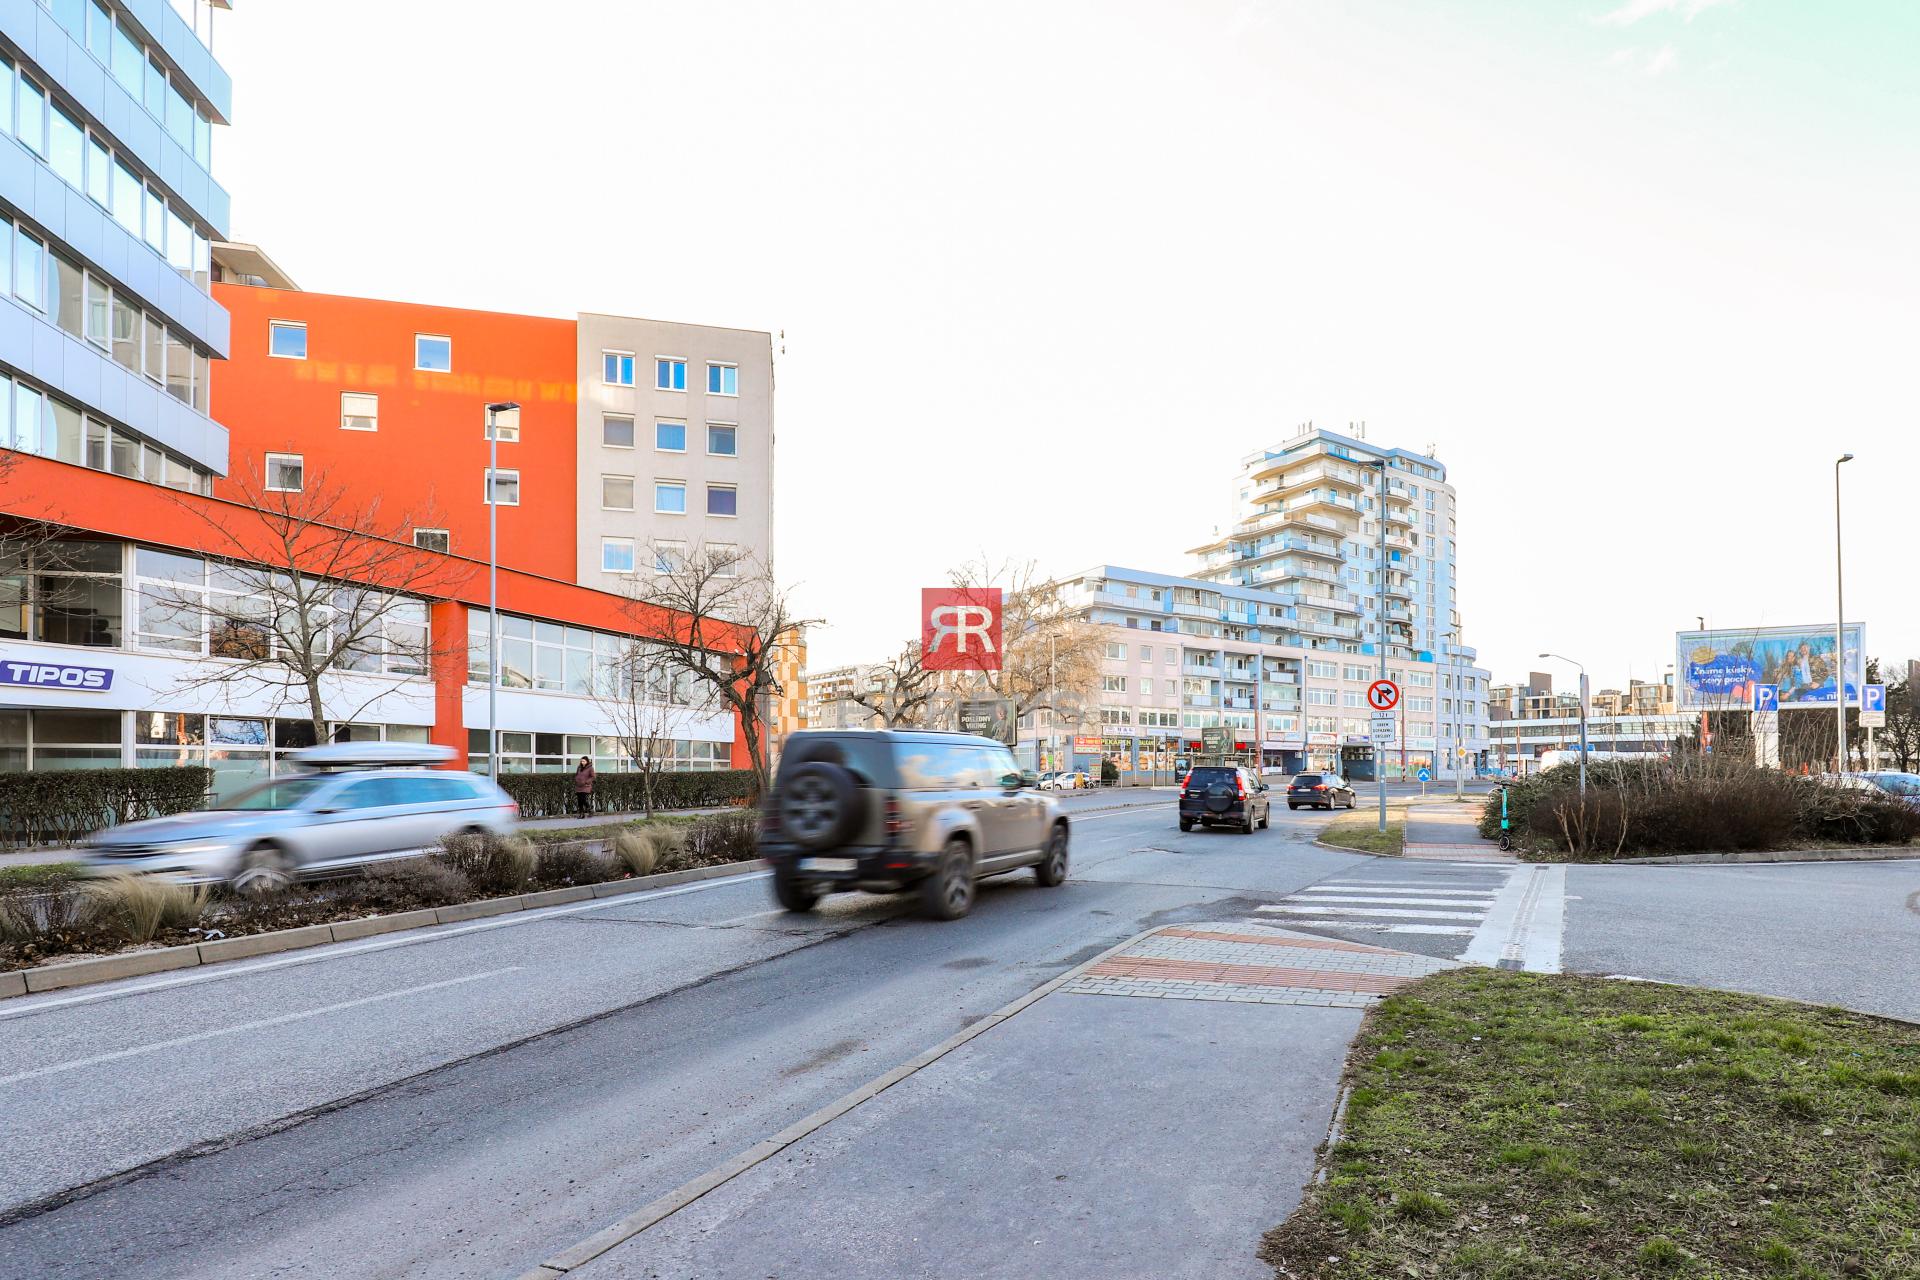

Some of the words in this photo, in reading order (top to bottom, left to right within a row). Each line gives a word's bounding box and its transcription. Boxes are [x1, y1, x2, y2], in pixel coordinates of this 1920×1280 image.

[7, 663, 106, 687] TIPOS
[1759, 687, 1773, 709] P
[1866, 688, 1880, 709] P
